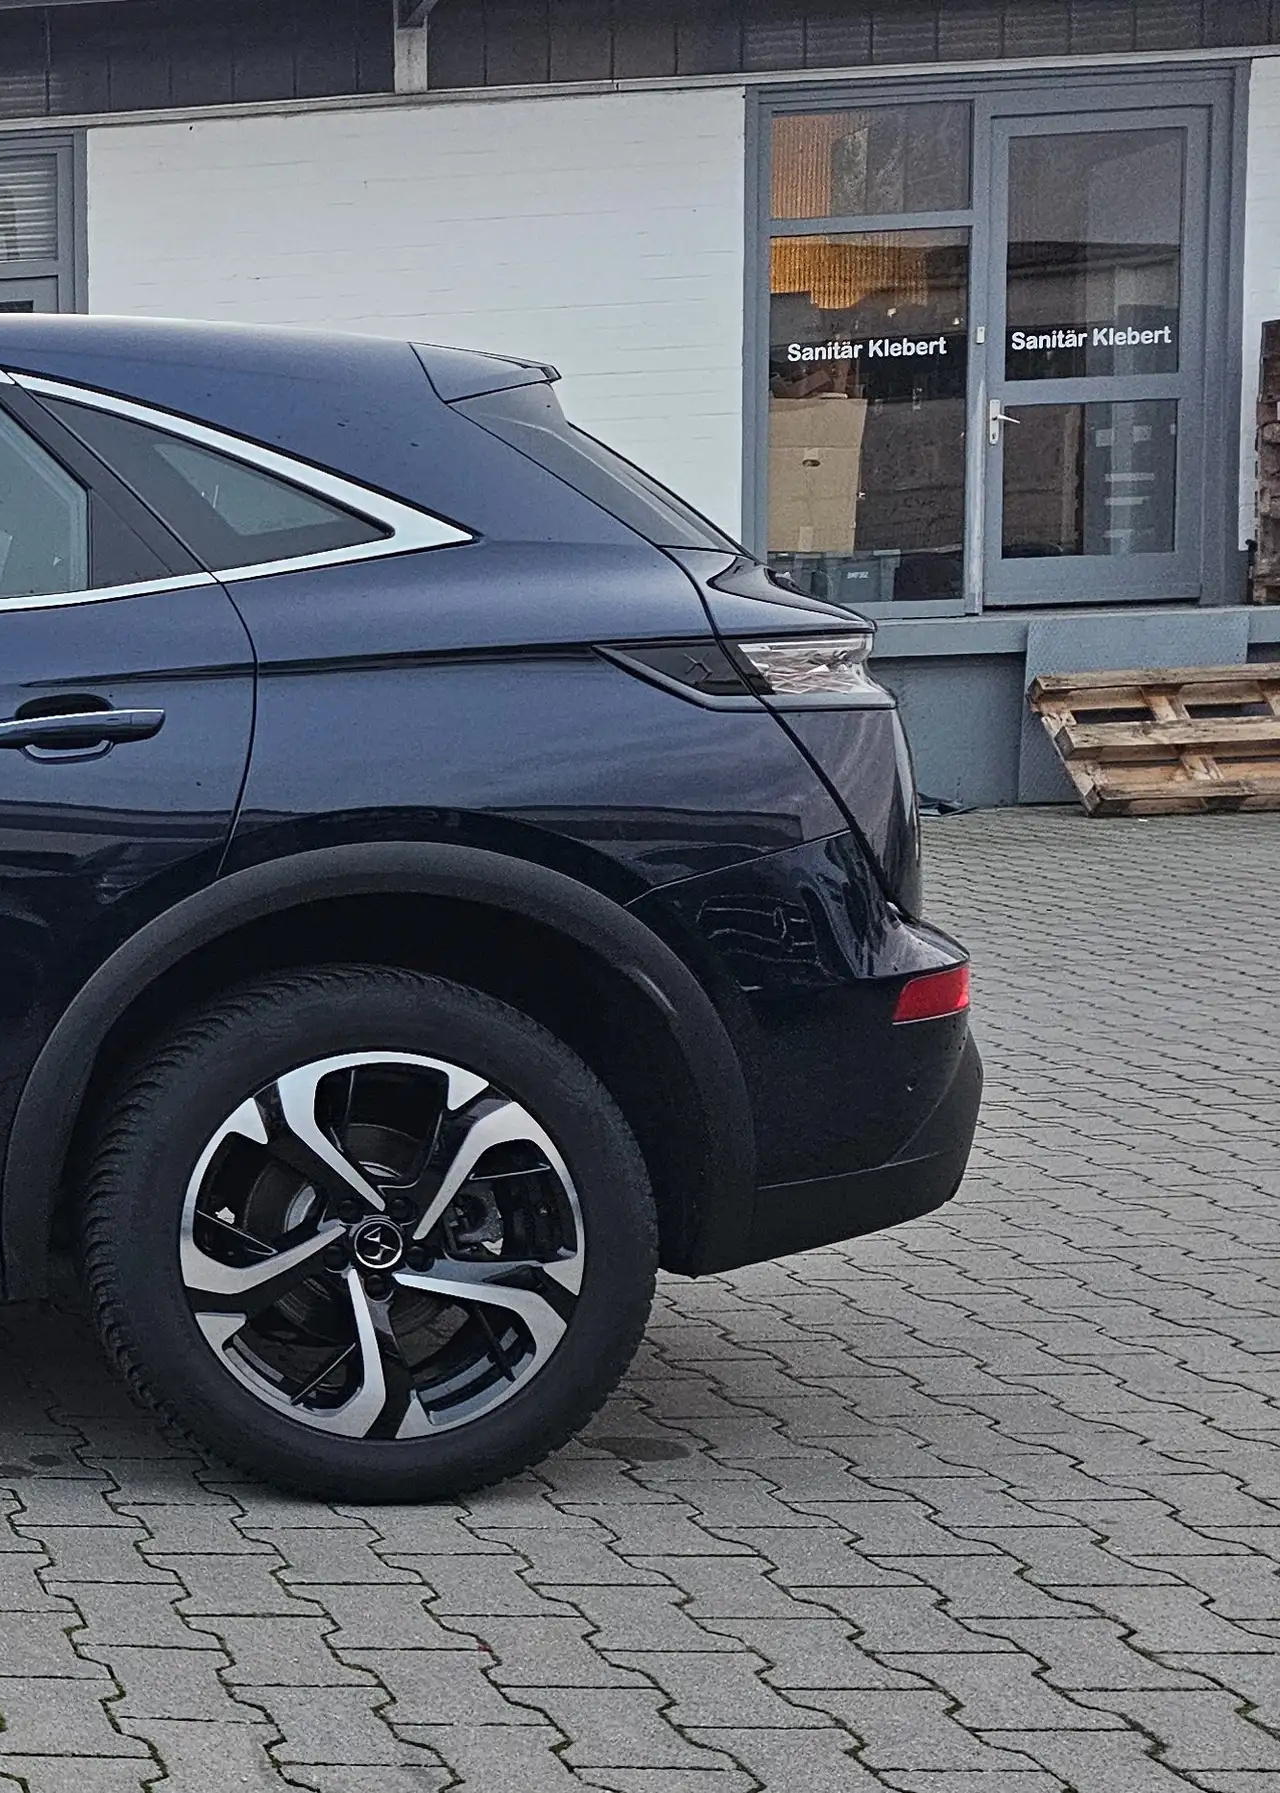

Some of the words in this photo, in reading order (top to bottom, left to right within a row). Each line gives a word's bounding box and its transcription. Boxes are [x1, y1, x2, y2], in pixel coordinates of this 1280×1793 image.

[787, 339, 862, 362] Sanitär
[868, 336, 948, 359] Klebert
[1011, 329, 1088, 351] Sanitär
[1092, 325, 1172, 347] Klebert
